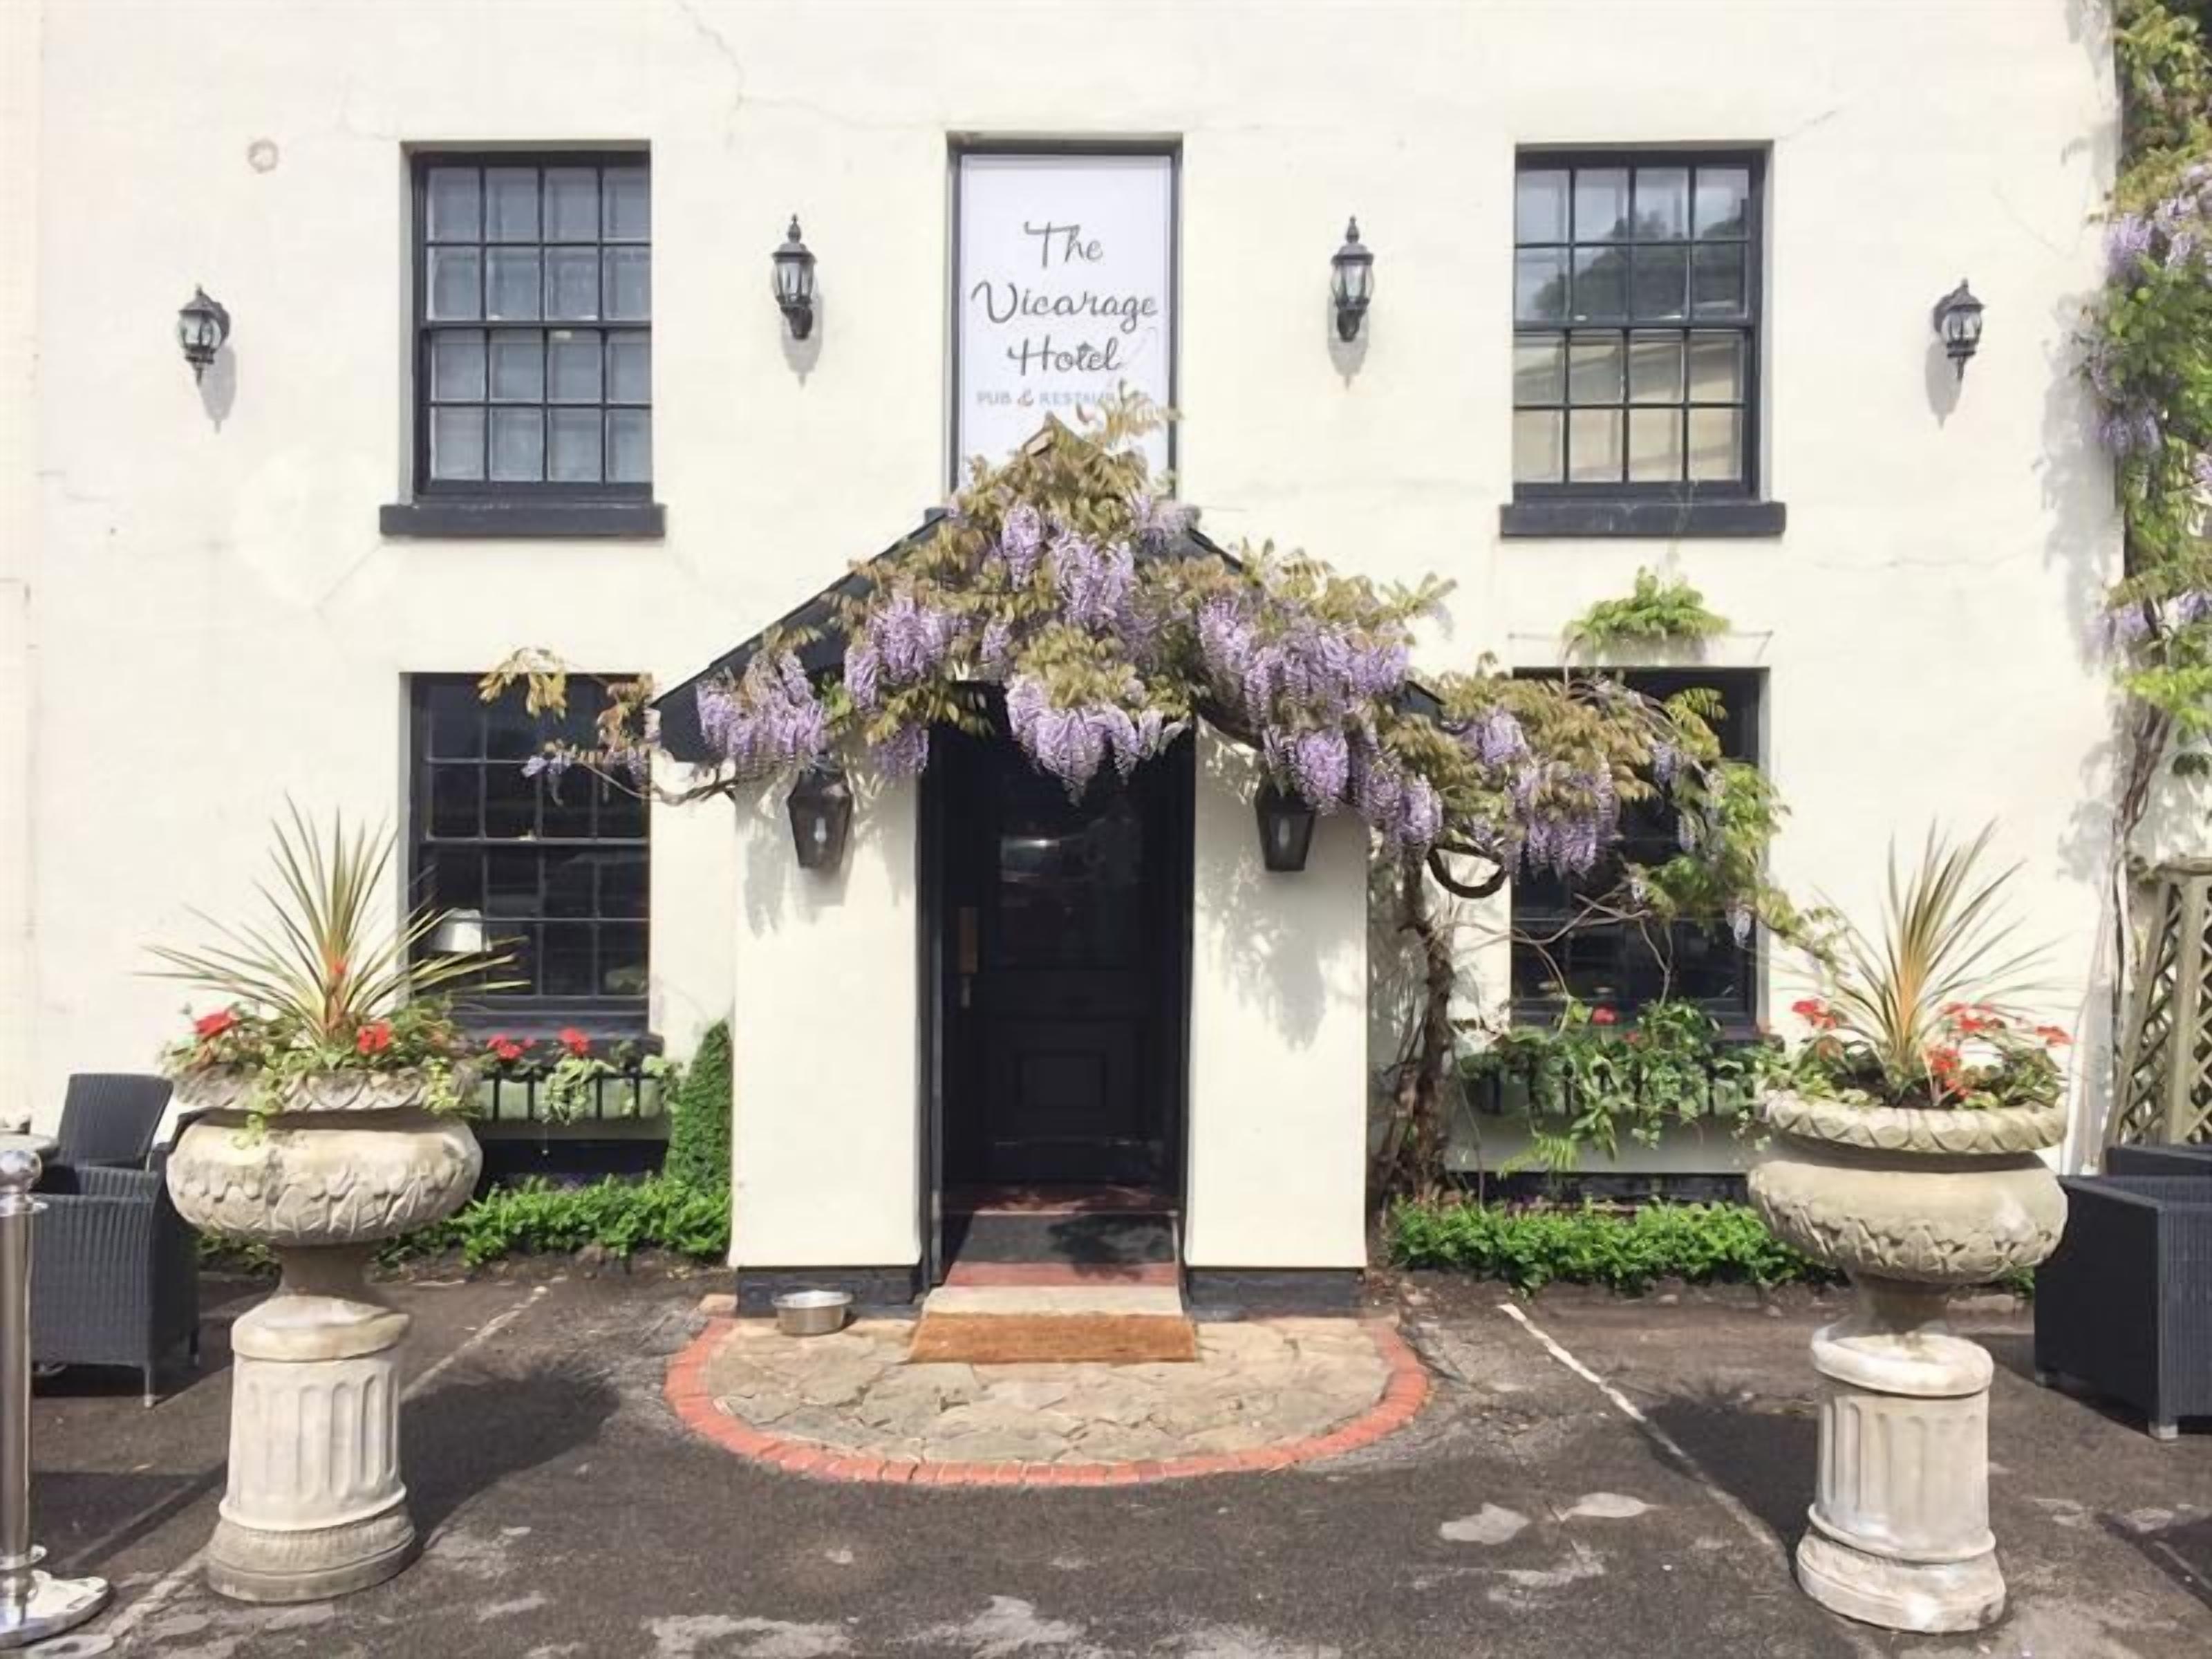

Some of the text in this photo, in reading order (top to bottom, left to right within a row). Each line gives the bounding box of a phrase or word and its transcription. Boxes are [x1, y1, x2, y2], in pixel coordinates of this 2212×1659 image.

[1023, 221, 1104, 268] The
[971, 280, 1159, 335] Vicarage
[1006, 335, 1123, 376] Hotel
[976, 391, 1011, 406] PUB
